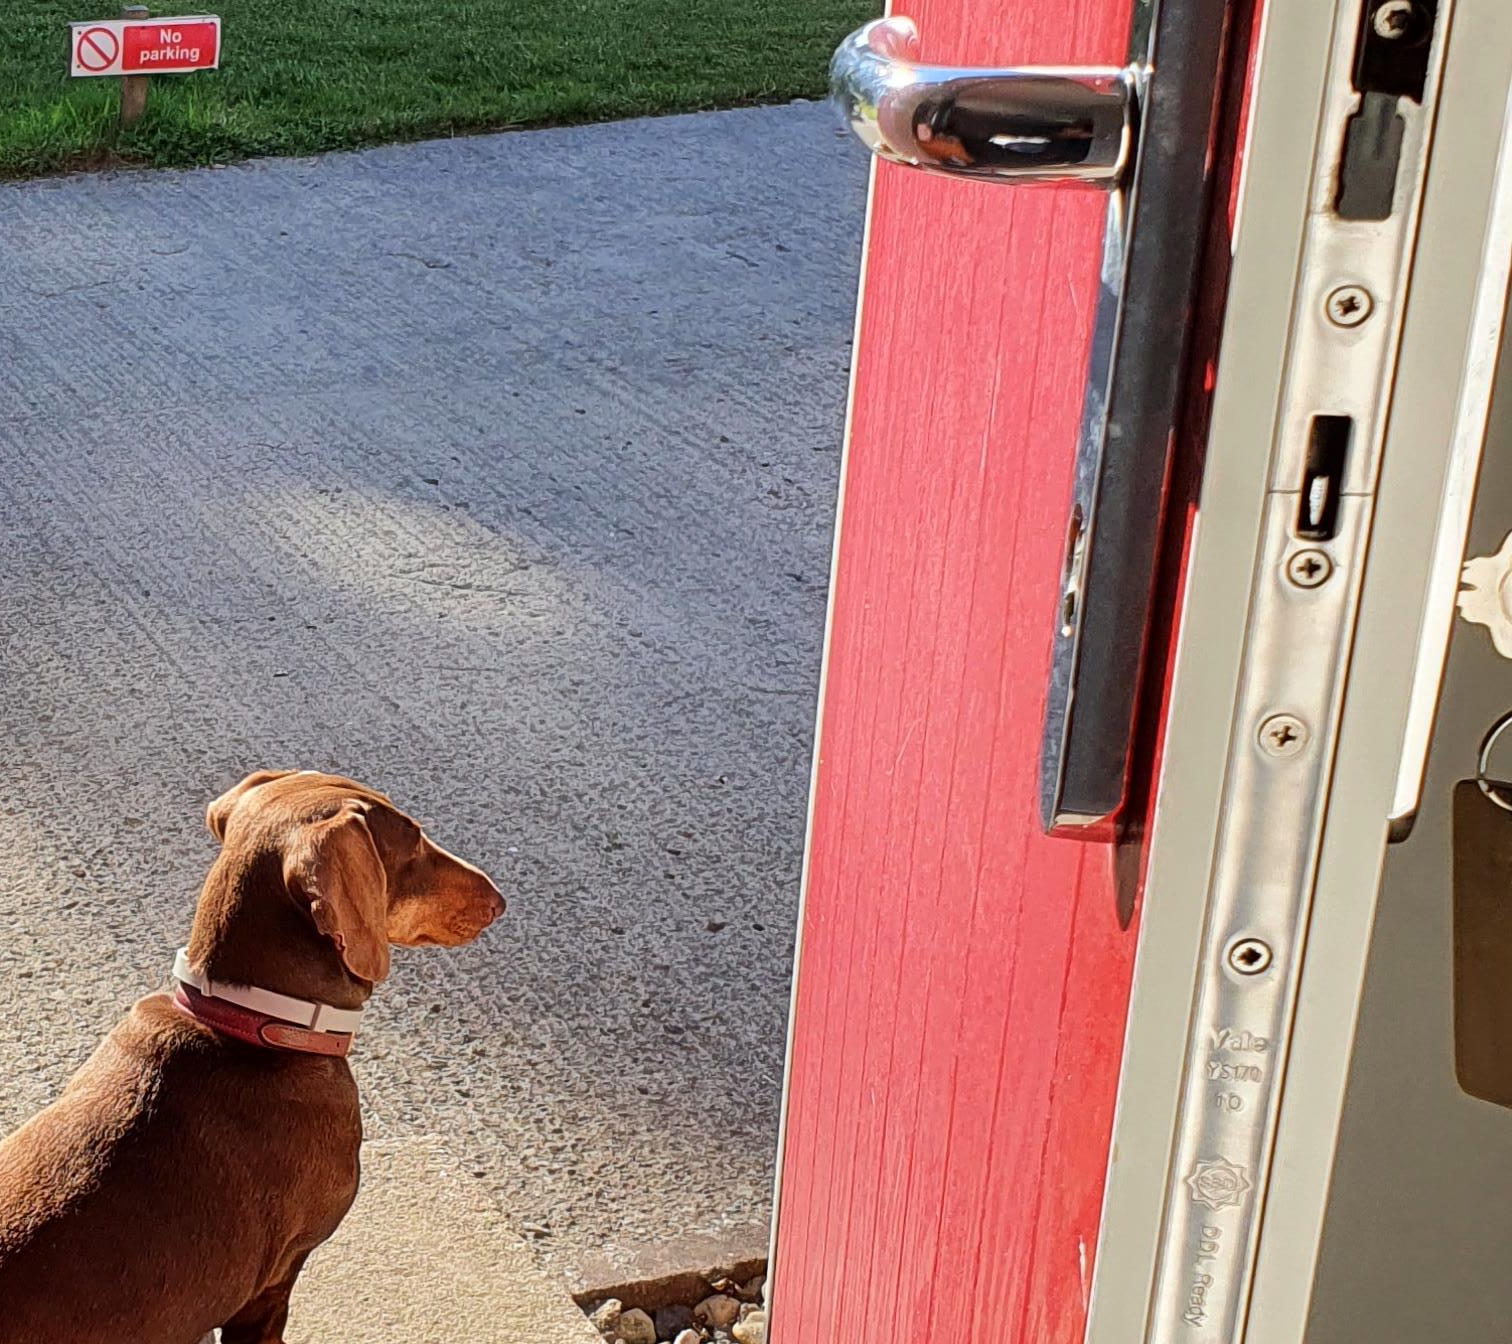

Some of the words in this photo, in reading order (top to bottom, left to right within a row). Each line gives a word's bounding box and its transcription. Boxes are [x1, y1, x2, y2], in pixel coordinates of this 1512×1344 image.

[160, 28, 182, 43] No
[140, 46, 200, 64] parking
[1209, 1028, 1269, 1053] Yale
[1184, 1273, 1214, 1327] Ready
